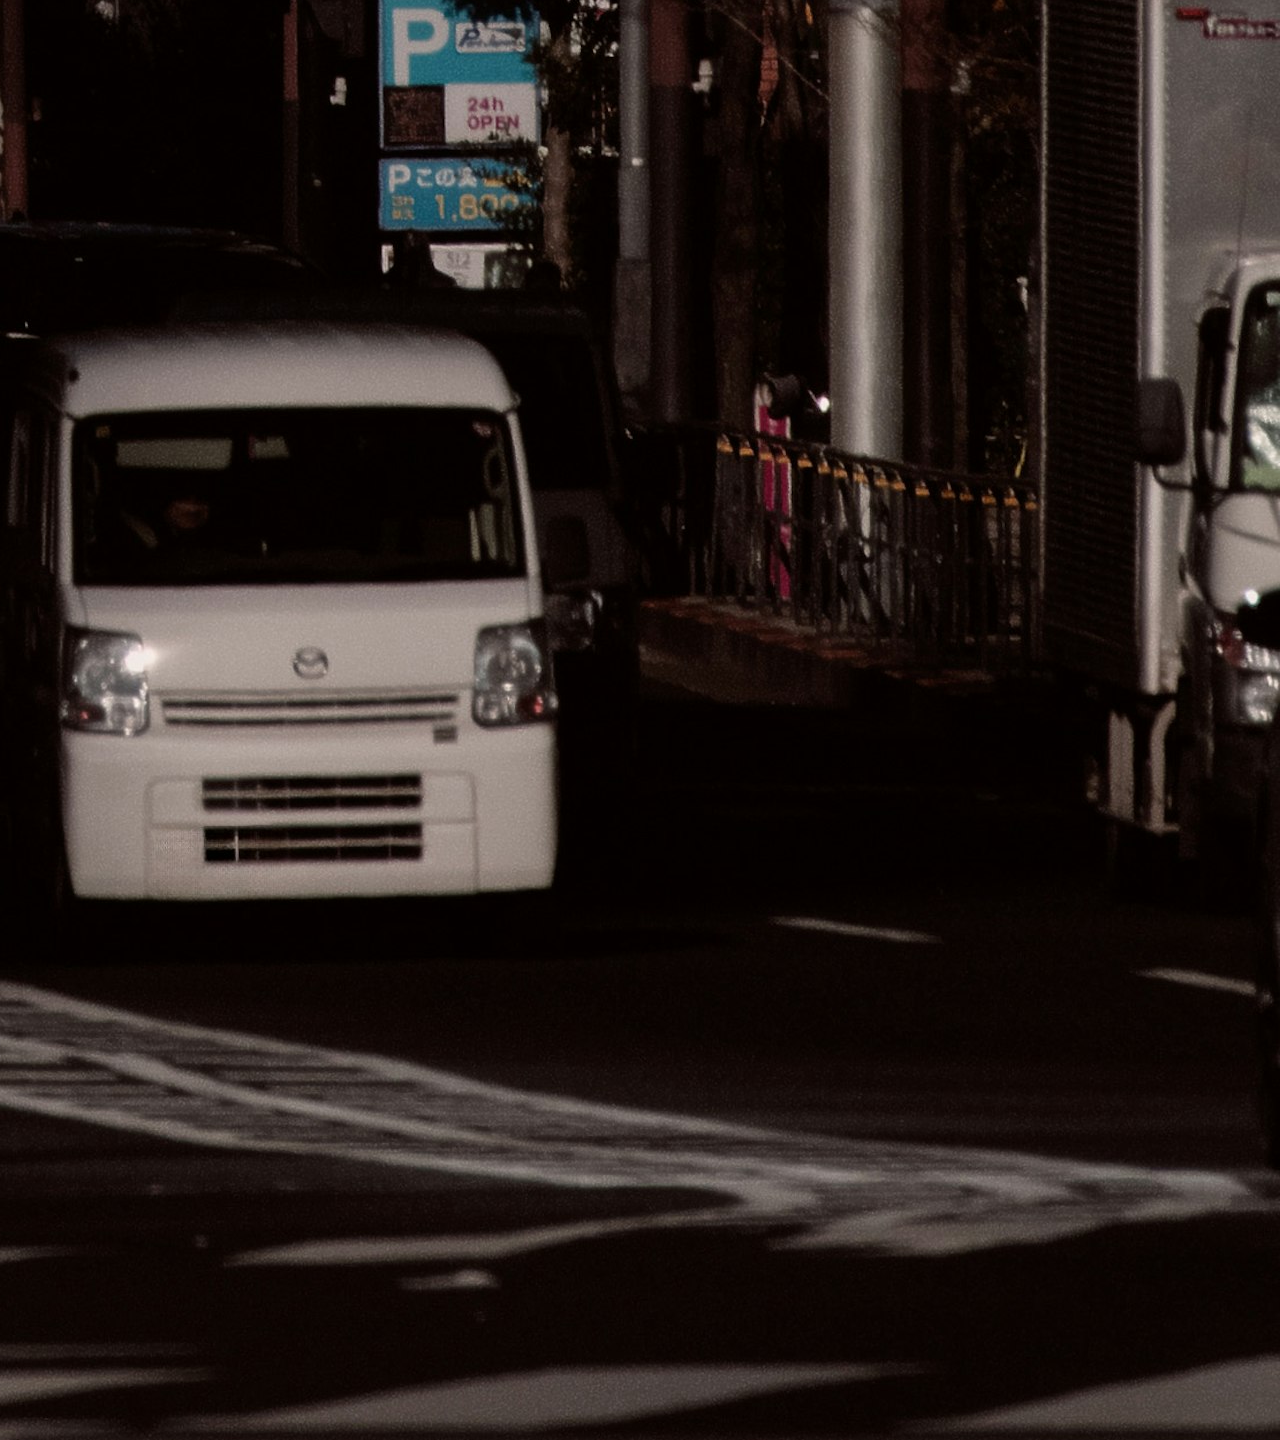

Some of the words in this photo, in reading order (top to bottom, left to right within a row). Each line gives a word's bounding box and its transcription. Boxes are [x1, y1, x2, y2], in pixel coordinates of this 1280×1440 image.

[392, 8, 449, 87] P
[467, 97, 504, 112] 24h
[467, 114, 520, 131] OPEN
